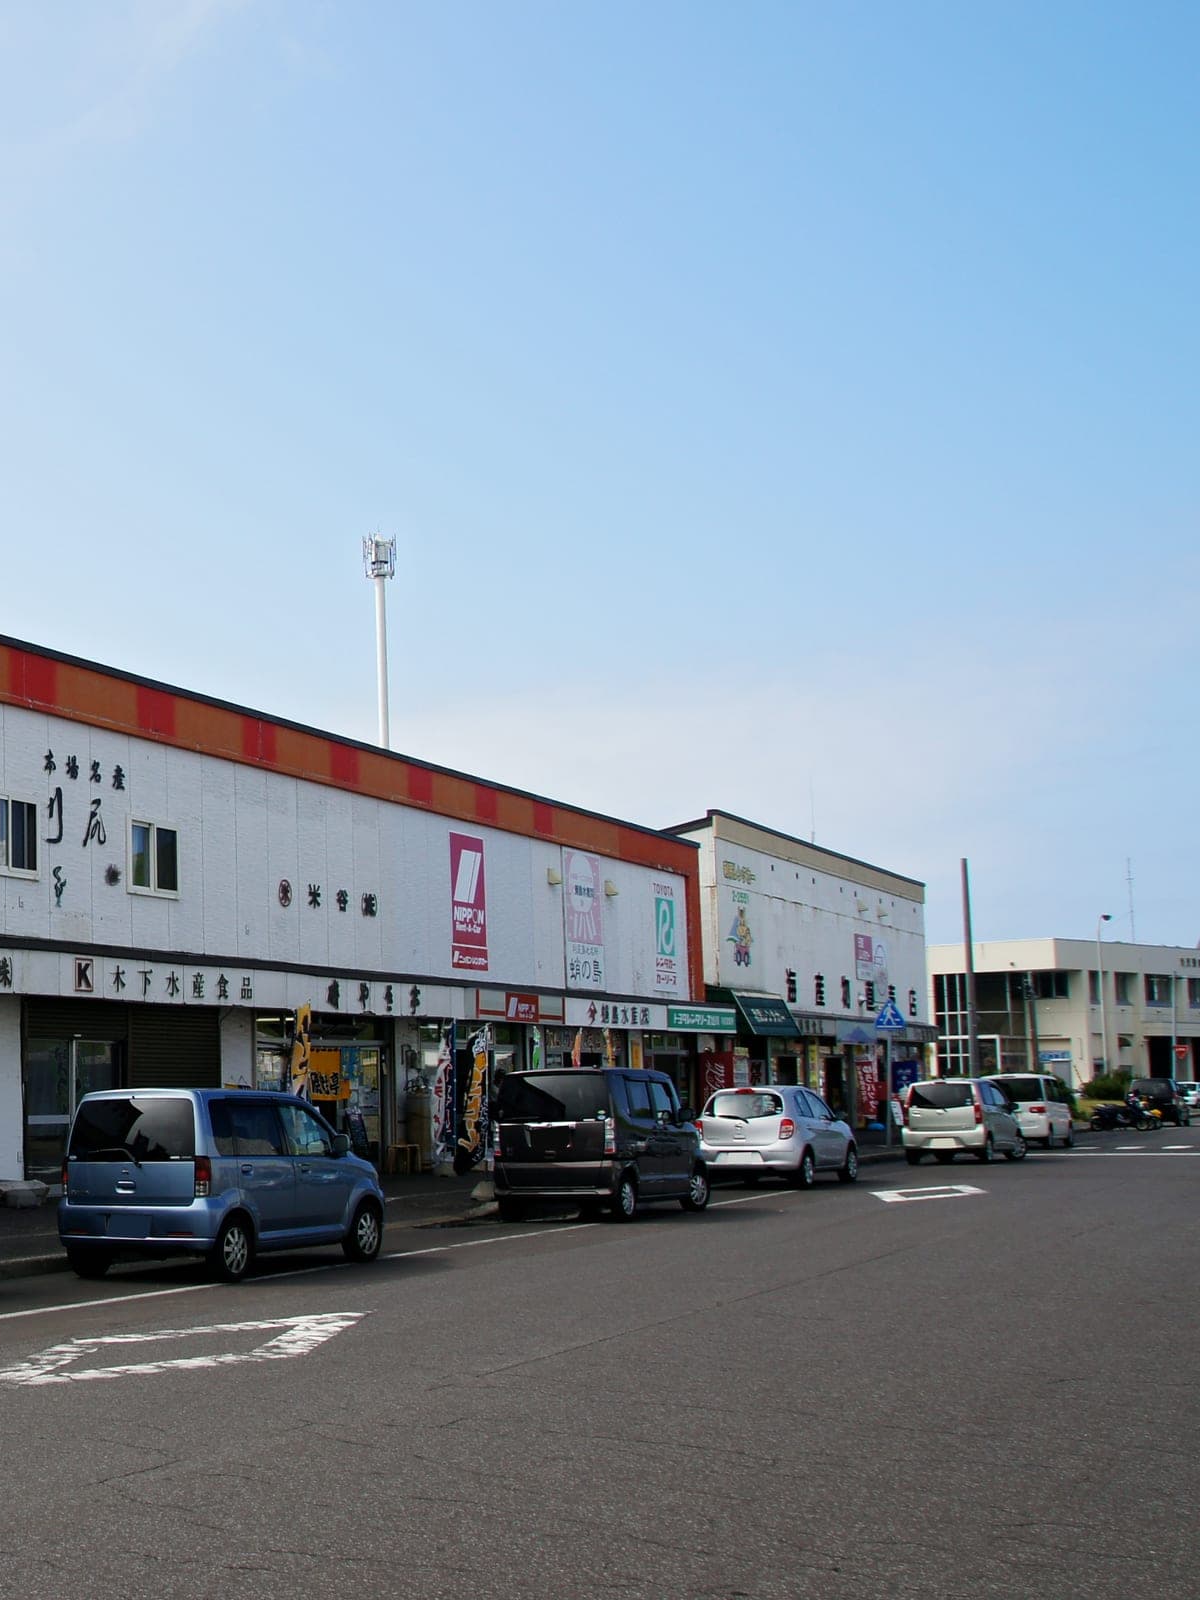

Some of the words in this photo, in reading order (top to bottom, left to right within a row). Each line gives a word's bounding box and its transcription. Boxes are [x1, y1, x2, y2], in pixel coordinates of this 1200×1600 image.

[653, 882, 674, 897] TOYOTA
[453, 905, 484, 925] NIPPON
[656, 957, 676, 970] レンタカー
[77, 962, 92, 989] K
[110, 965, 252, 1000] 木下水産食品
[656, 975, 677, 986] カーリース
